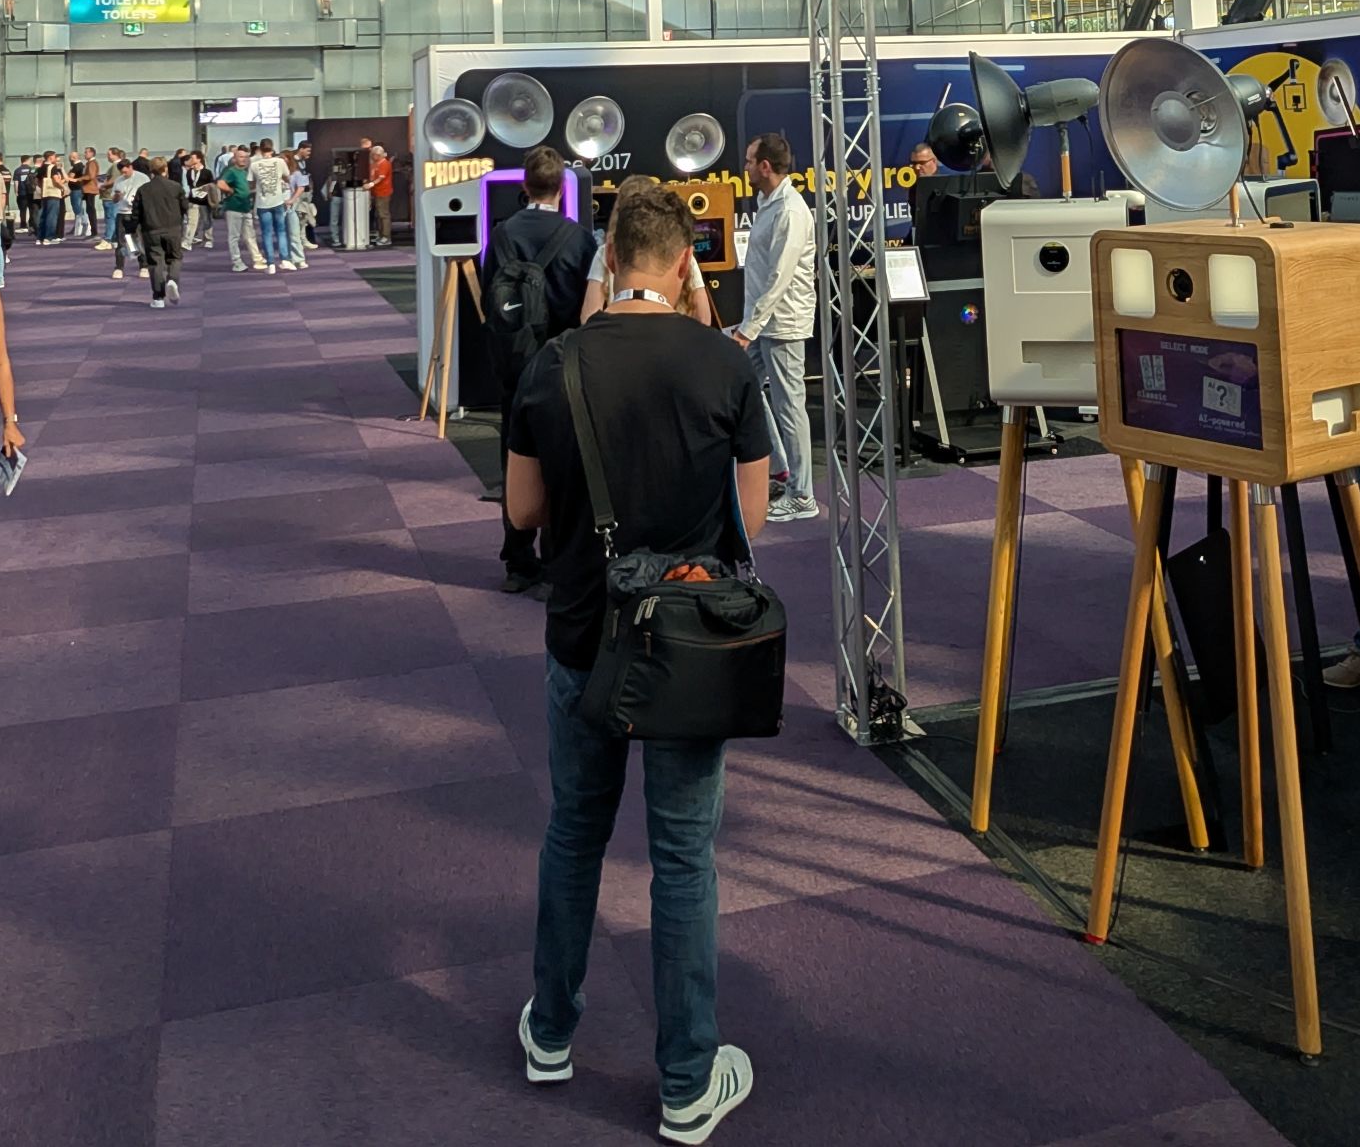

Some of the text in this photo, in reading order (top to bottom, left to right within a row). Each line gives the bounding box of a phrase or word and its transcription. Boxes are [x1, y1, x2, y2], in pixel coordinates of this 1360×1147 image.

[102, 10, 157, 20] TOILETS
[591, 152, 632, 172] 2017
[424, 157, 494, 189] PHOTOS
[1160, 341, 1209, 355] SELECT MODE
